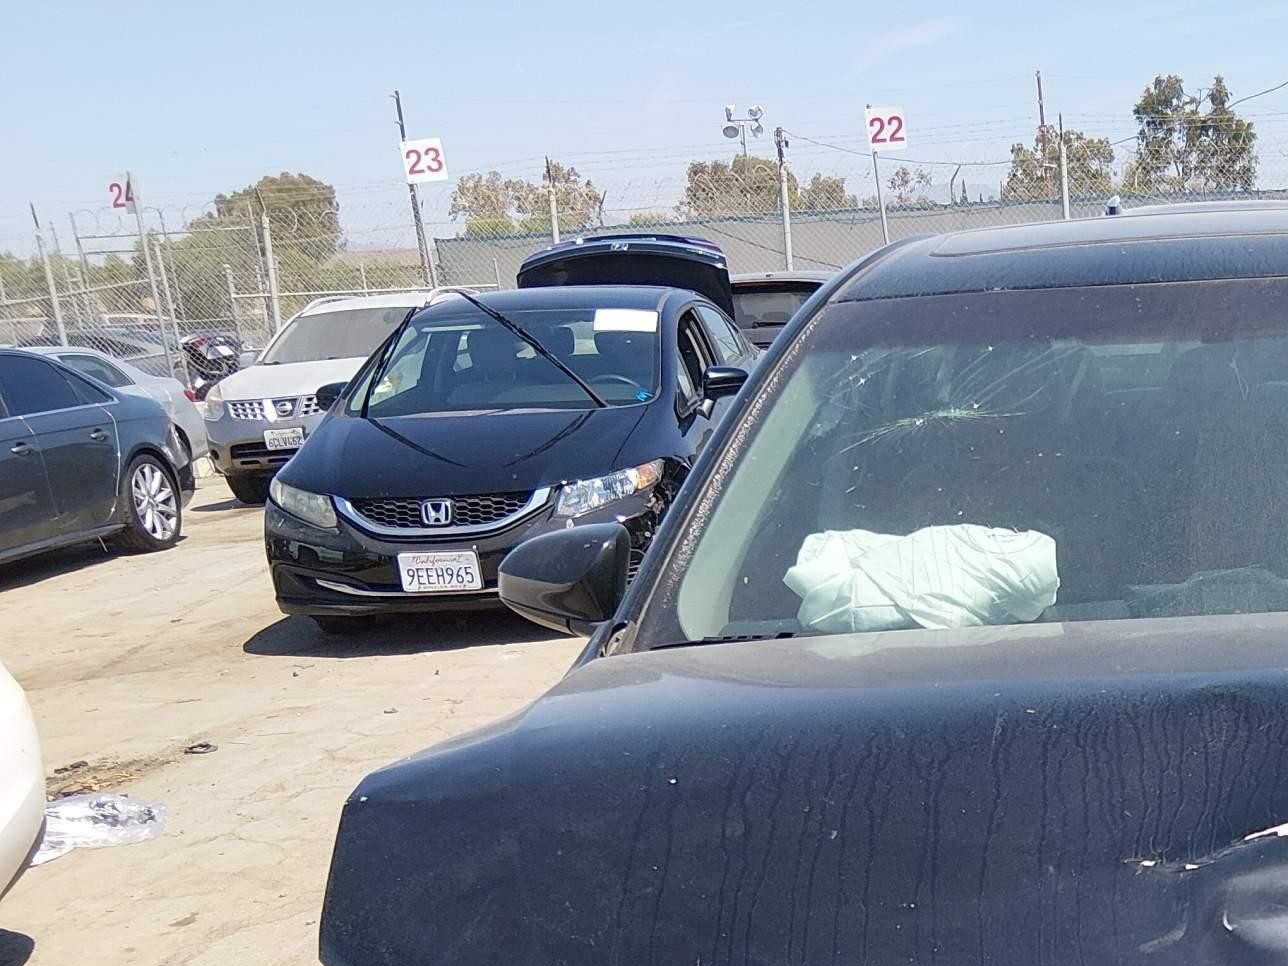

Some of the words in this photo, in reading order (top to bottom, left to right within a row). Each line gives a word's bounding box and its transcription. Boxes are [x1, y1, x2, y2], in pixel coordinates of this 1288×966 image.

[869, 116, 905, 143] 22
[405, 147, 443, 175] 23
[406, 566, 475, 586] 9EEH965
